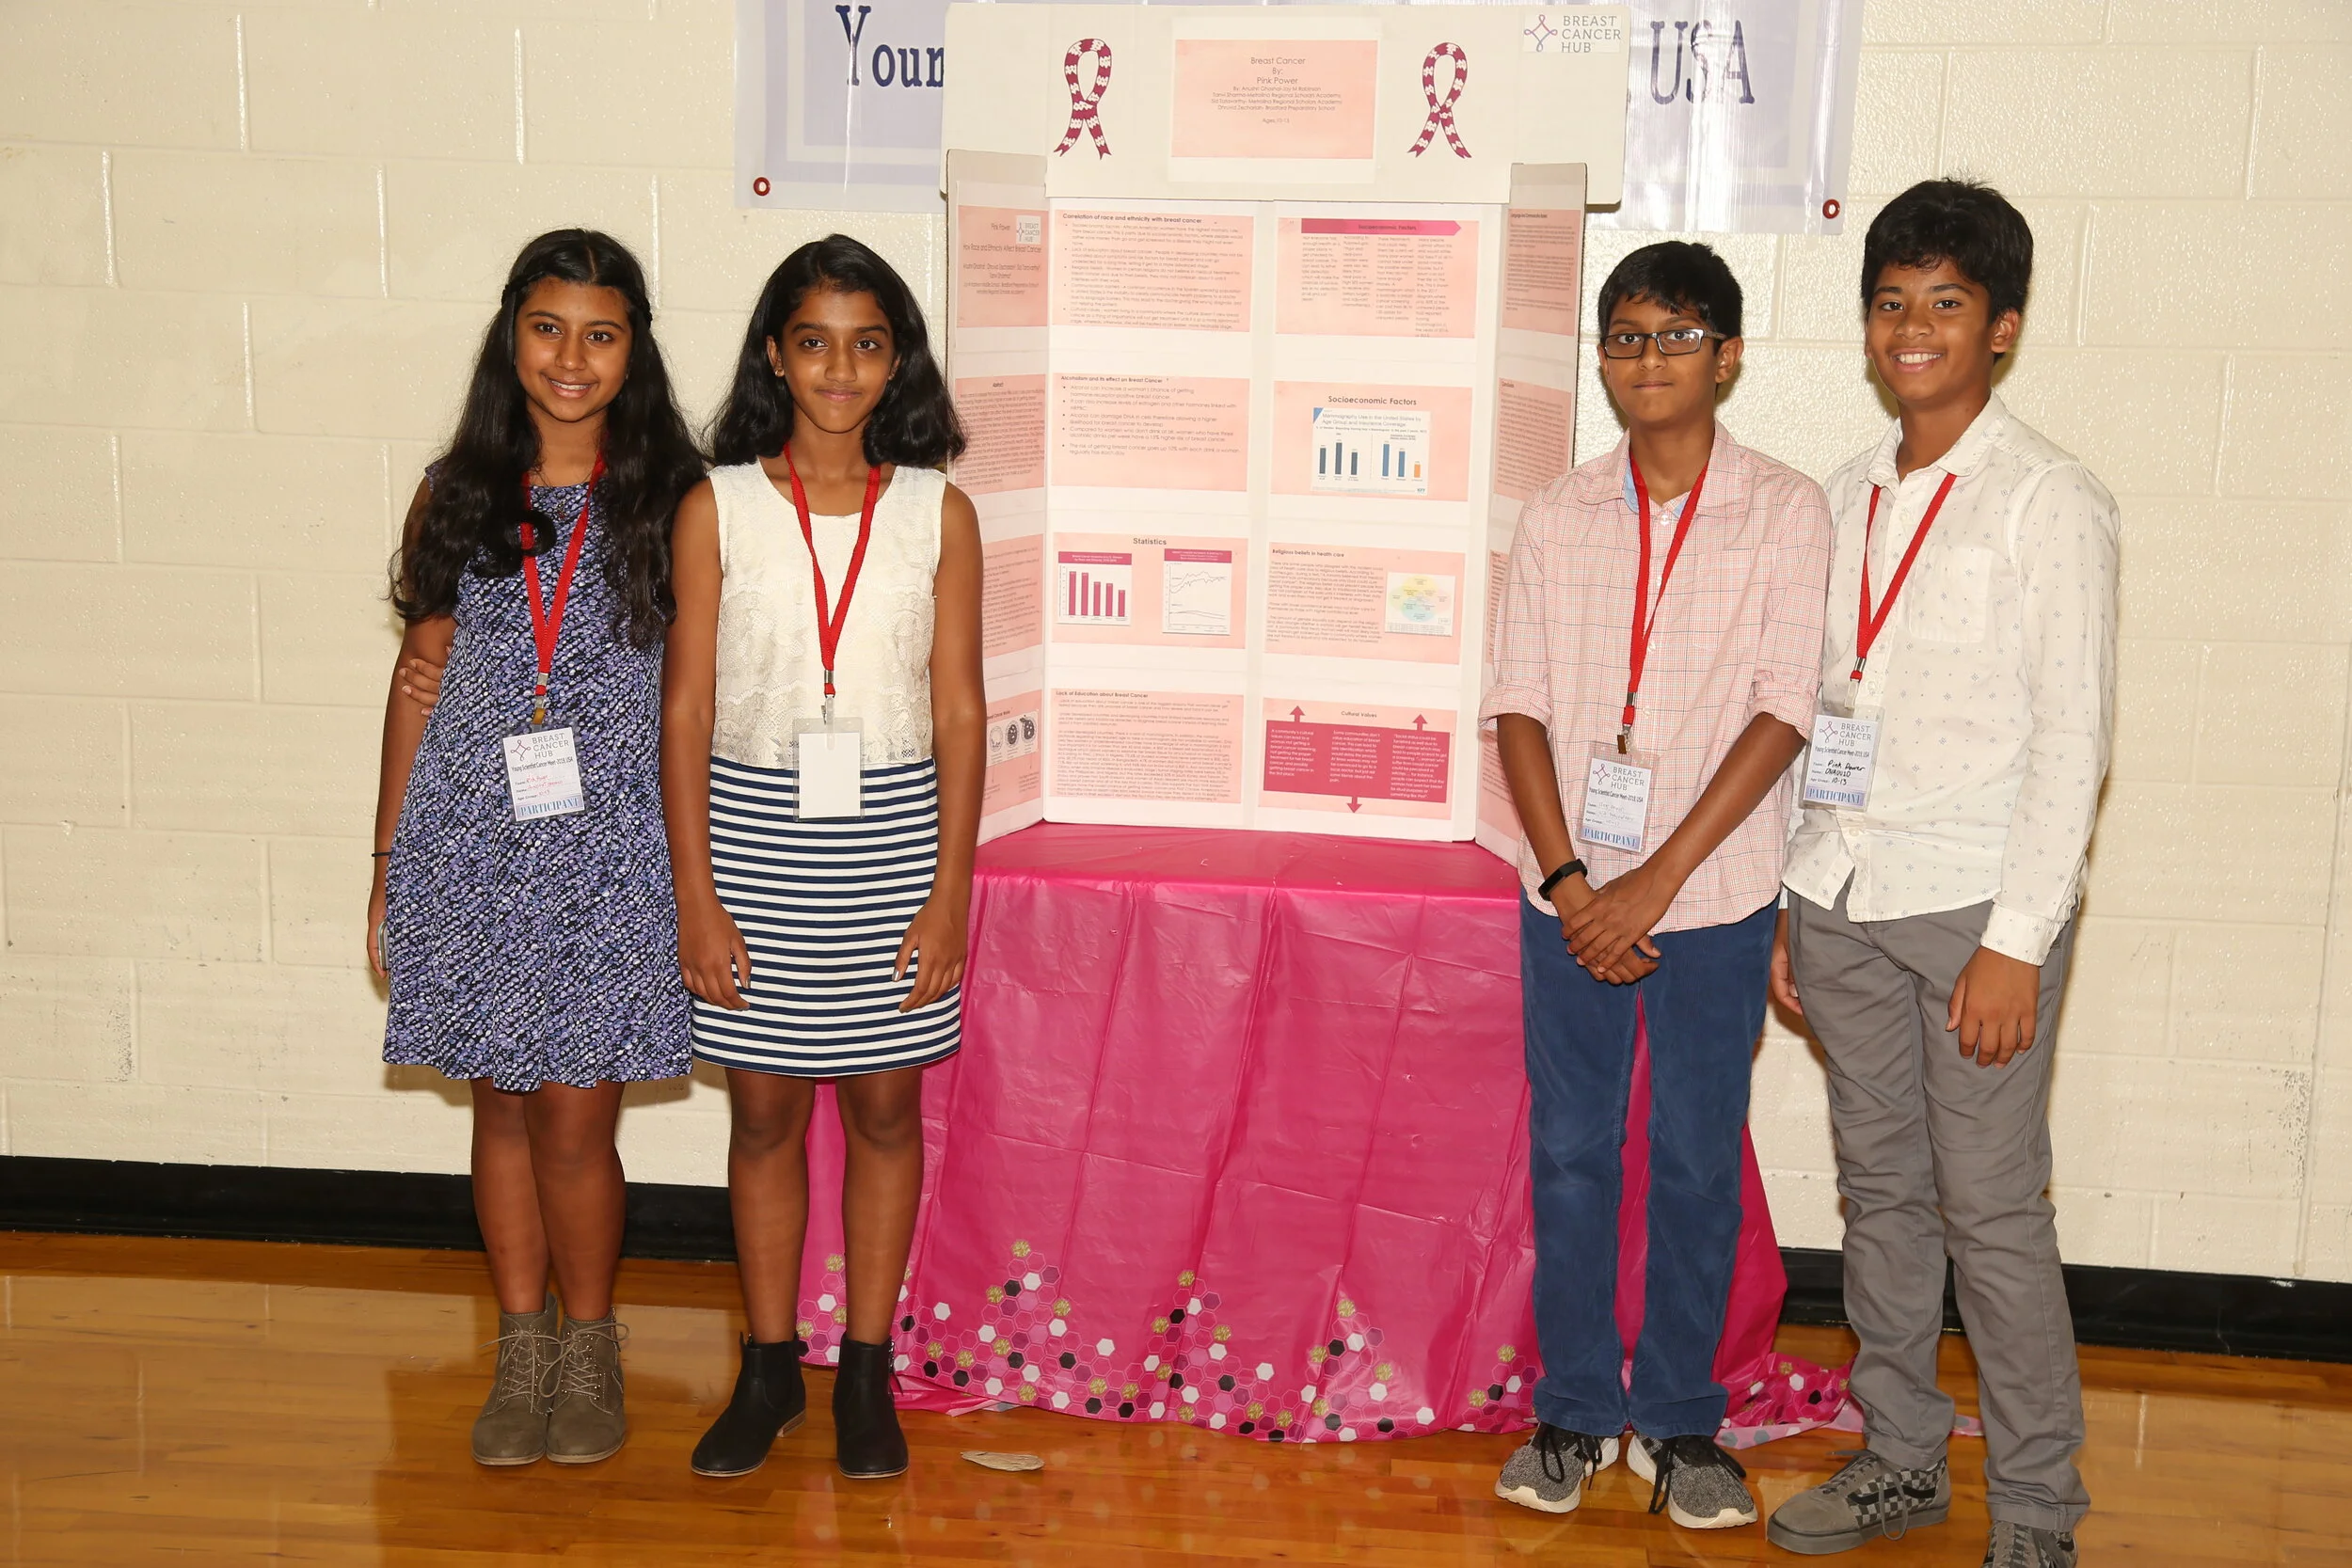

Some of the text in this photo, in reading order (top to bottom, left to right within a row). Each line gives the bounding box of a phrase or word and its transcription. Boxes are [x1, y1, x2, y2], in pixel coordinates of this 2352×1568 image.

[1563, 16, 1617, 26] BREAST
[1562, 29, 1621, 40] CANCER
[835, 5, 944, 87] Youn
[1561, 42, 1591, 53] HUB
[1650, 20, 1755, 104] USA
[1328, 396, 1387, 404] Socioeconomic
[1841, 723, 1870, 733] BREAST
[532, 733, 564, 744] BREAST
[1840, 731, 1872, 741] CANCER
[533, 740, 569, 751] CANCER
[535, 750, 553, 759] HUB
[1828, 760, 1865, 771] Pink Power
[1613, 766, 1642, 778] BREAST
[1612, 773, 1644, 786] CANCER
[1611, 782, 1627, 791] HUB
[1810, 788, 1860, 803] PARTICIPANT
[521, 798, 579, 816] PARTICIPANT
[1584, 828, 1636, 847] PARTICIPANT
